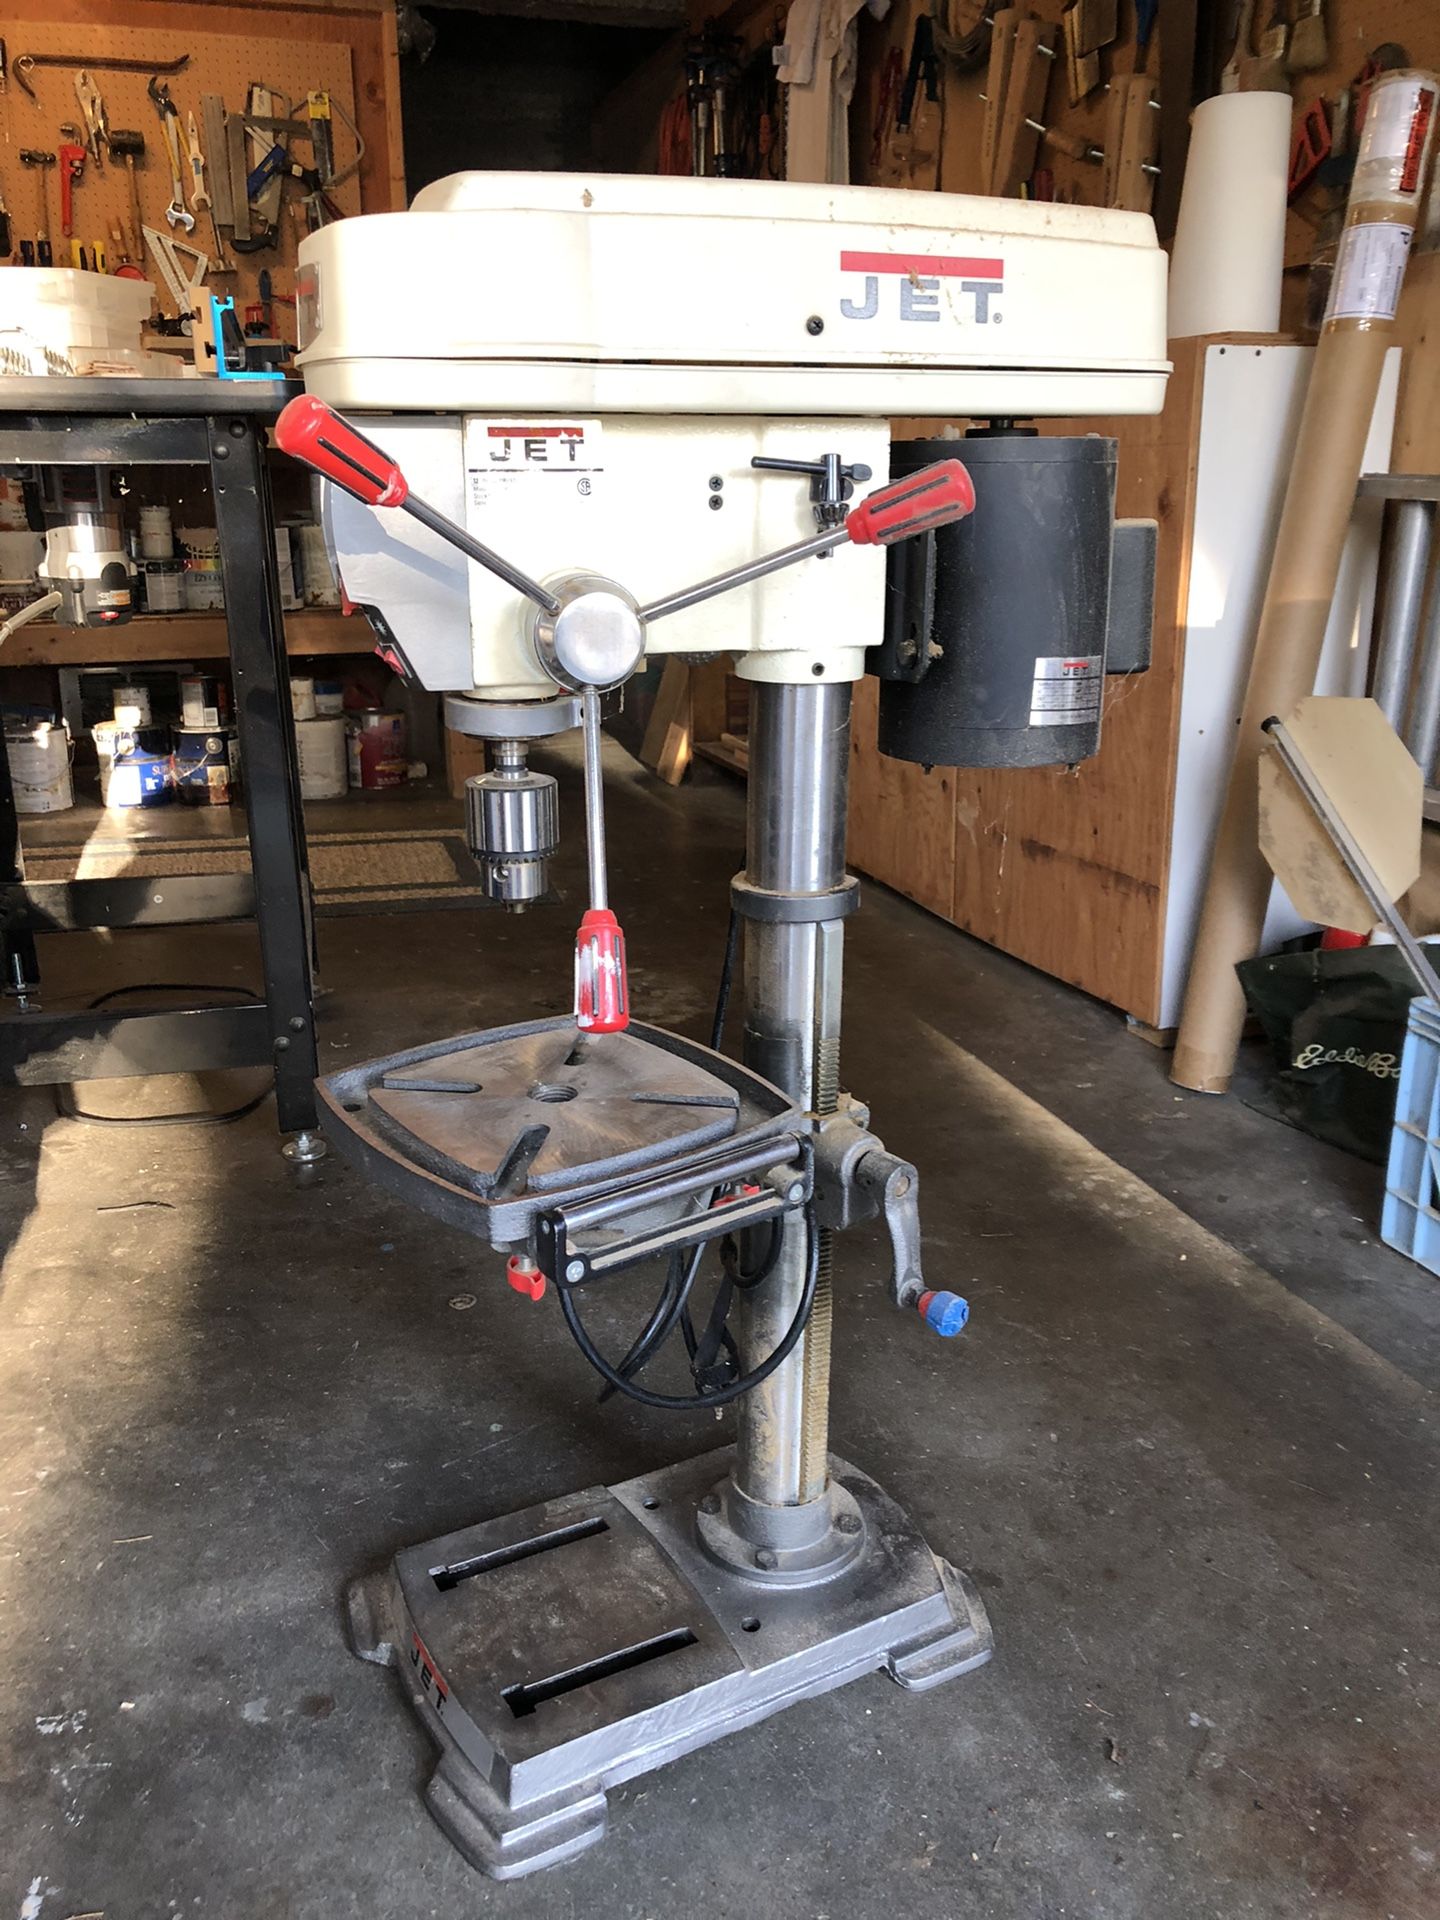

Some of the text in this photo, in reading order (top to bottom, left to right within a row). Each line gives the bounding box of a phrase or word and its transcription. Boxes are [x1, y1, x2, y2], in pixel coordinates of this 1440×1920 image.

[840, 275, 1003, 323] JET
[489, 438, 584, 461] JET
[1063, 667, 1088, 676] JET
[411, 1648, 447, 1710] JET
